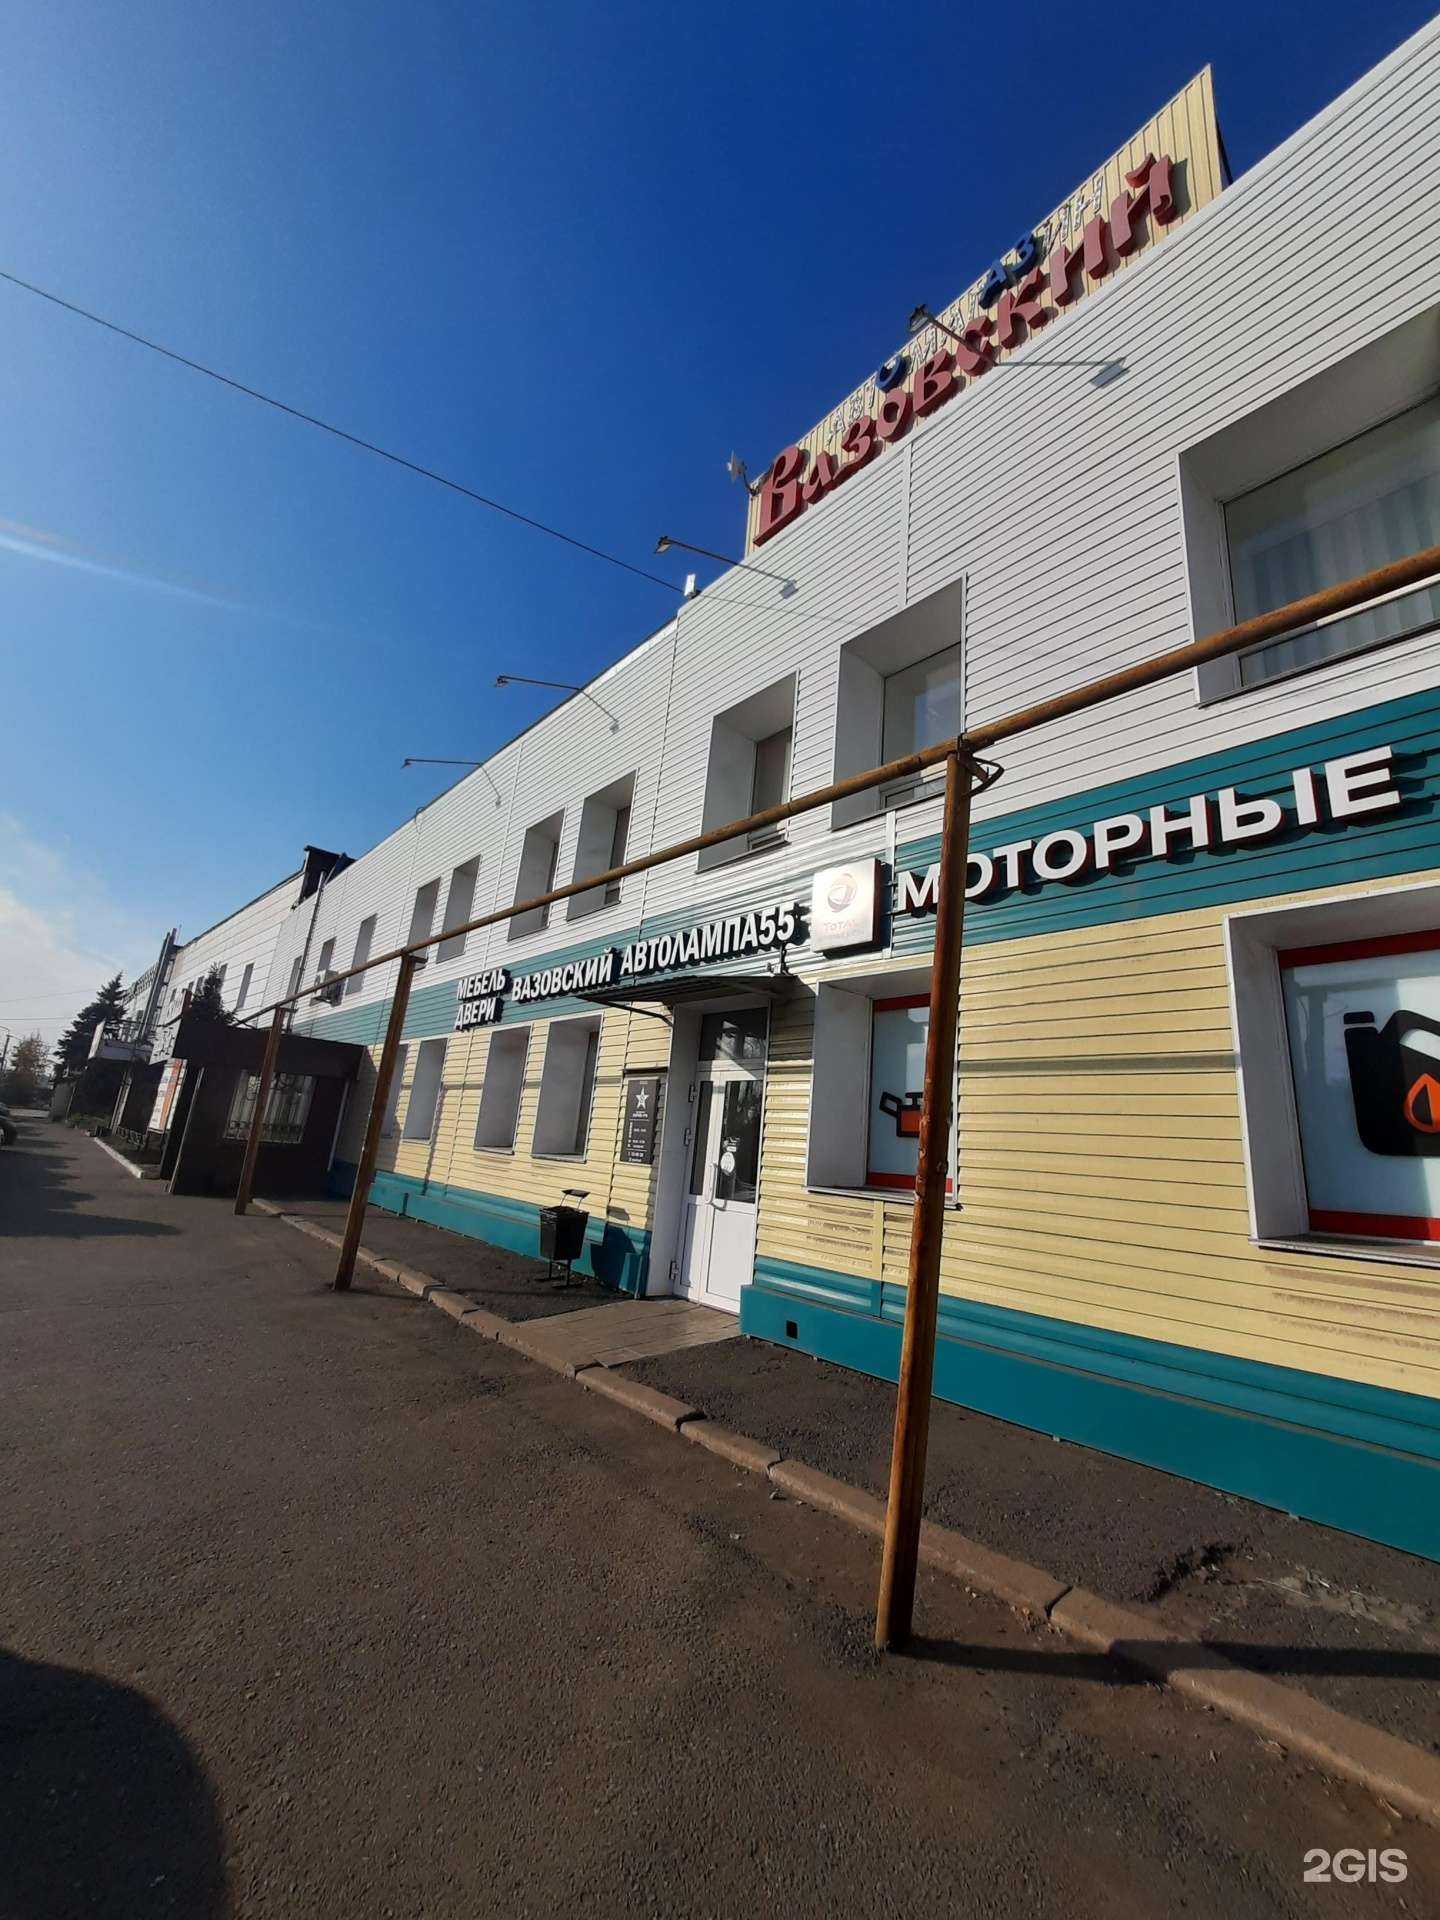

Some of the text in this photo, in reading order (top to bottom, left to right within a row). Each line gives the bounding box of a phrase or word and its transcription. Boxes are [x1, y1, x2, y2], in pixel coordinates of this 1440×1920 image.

[897, 745, 1400, 912] МОТОРНЫЕ
[620, 902, 796, 976] АВТОЛАМПА55
[457, 969, 506, 1000] МЕБЕЛЬ
[512, 948, 614, 1001] ВАЗОВСКИЙ
[454, 998, 497, 1030] ДВЕРИ
